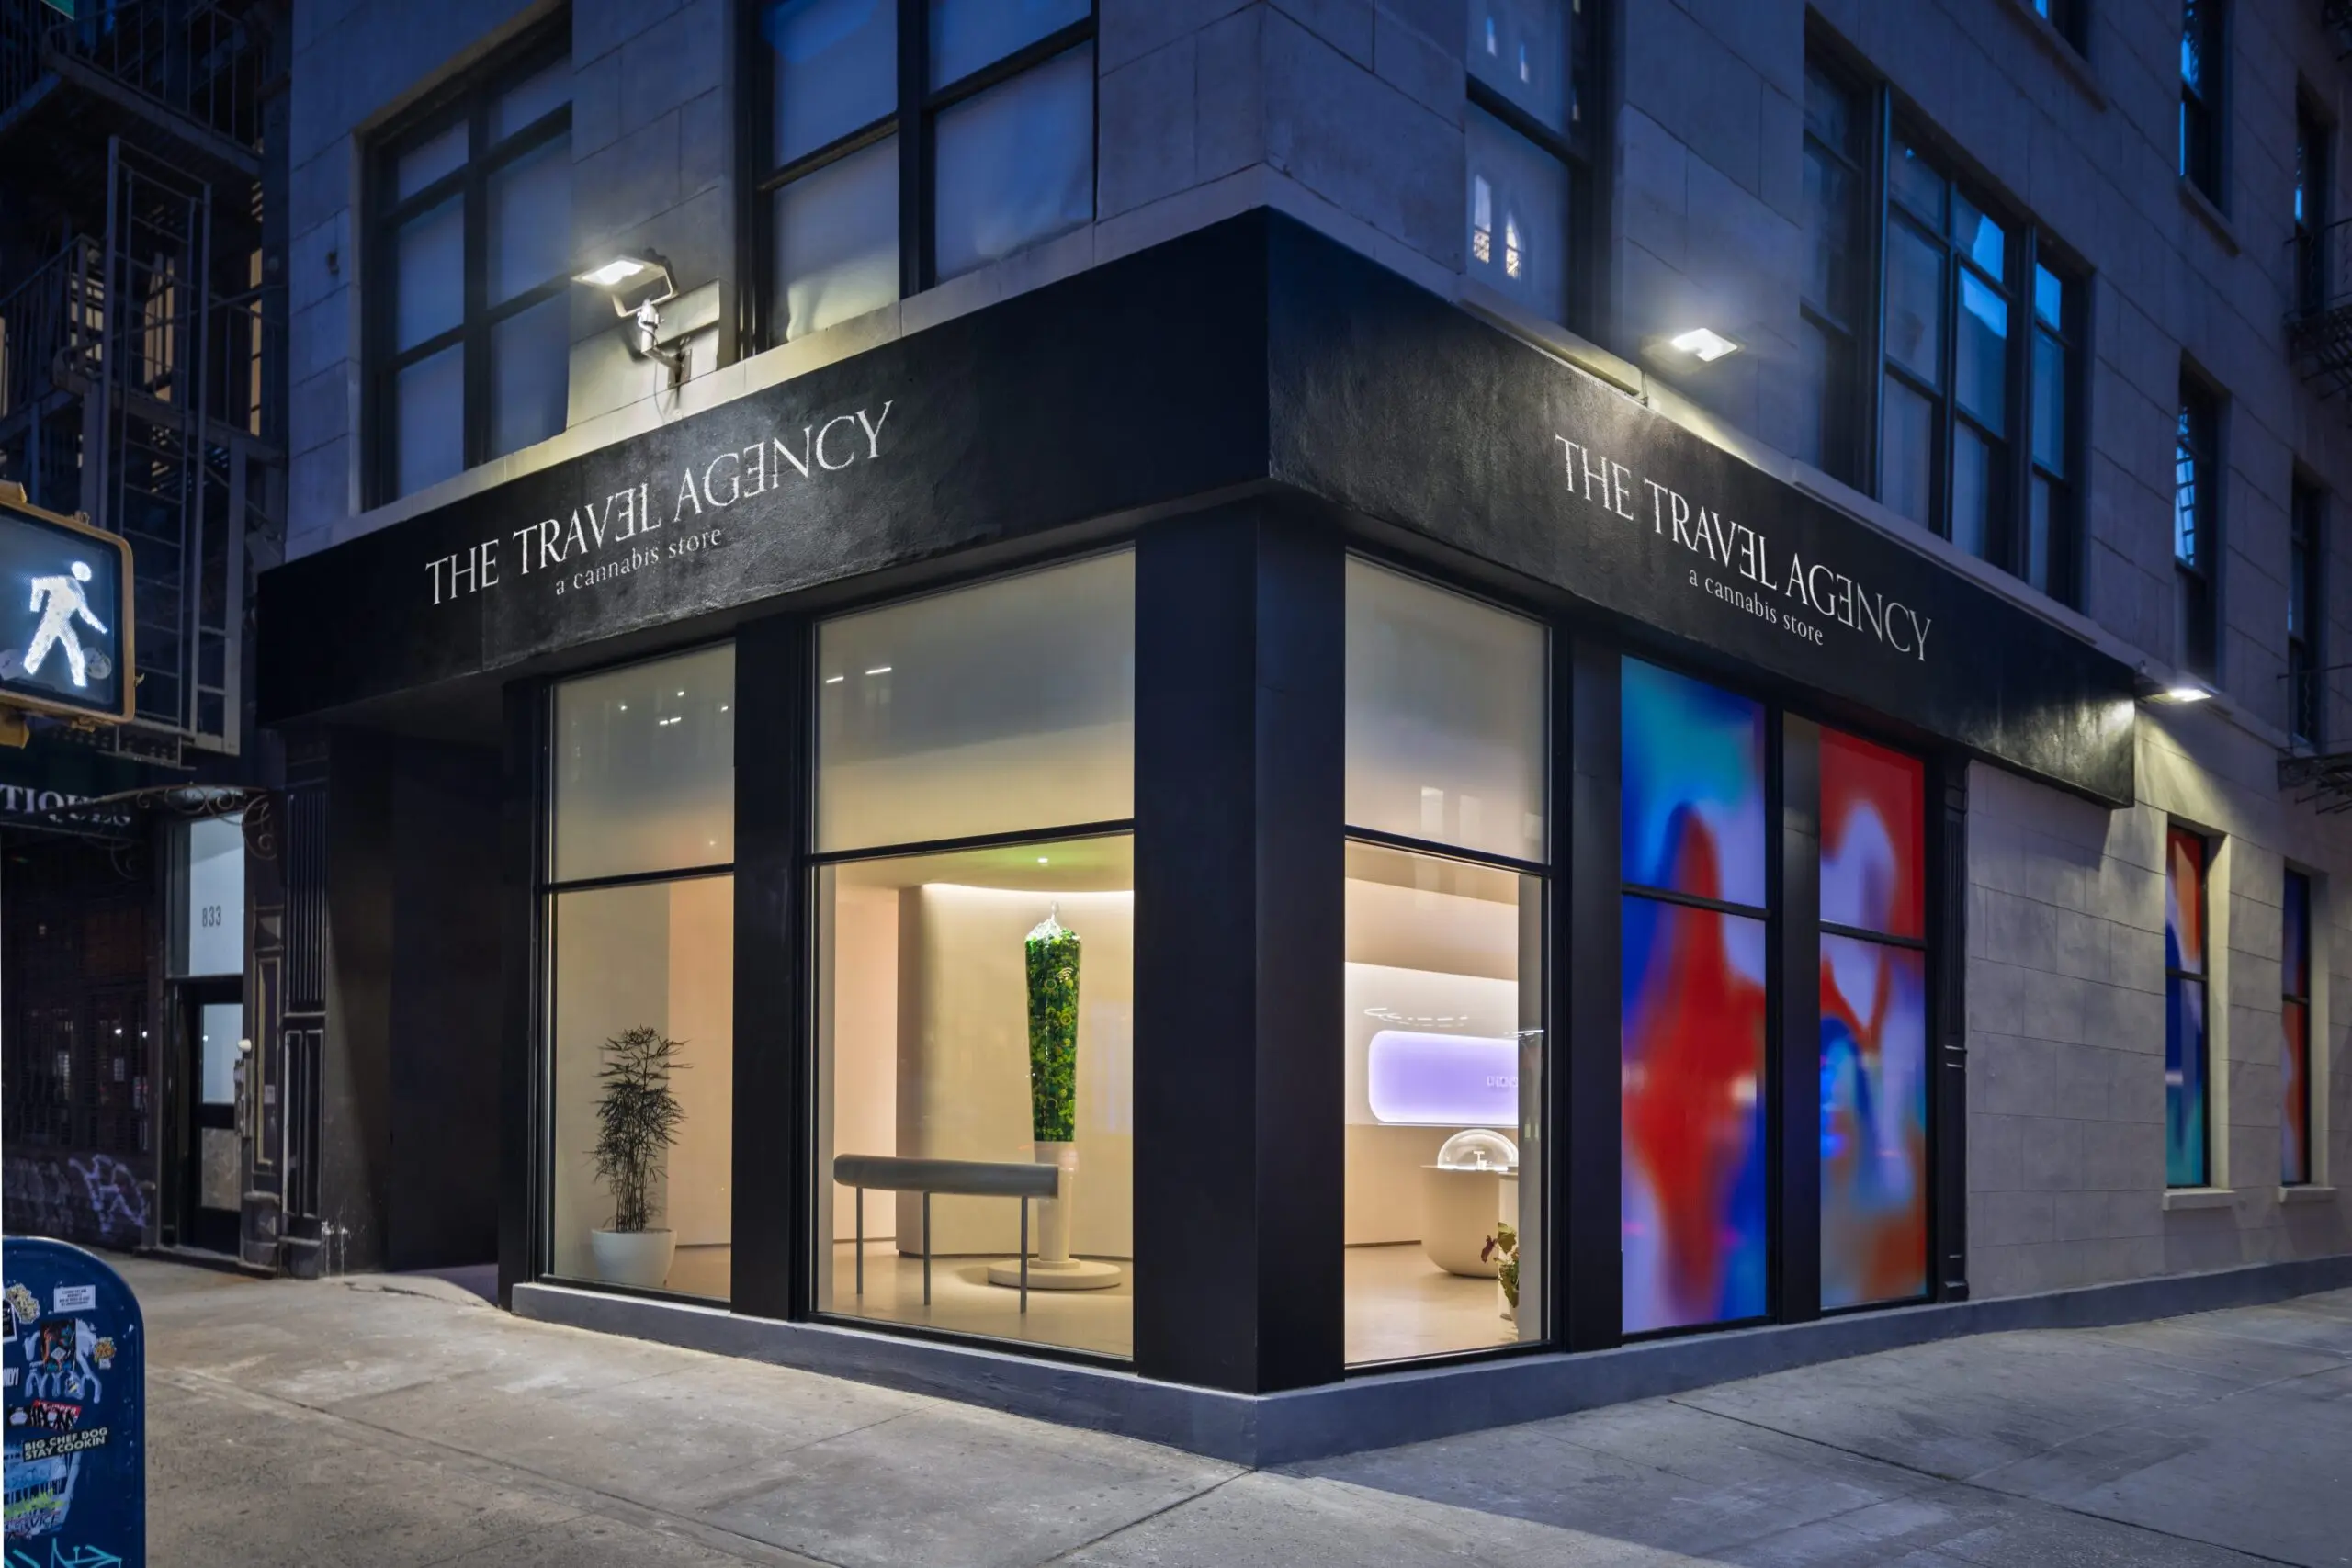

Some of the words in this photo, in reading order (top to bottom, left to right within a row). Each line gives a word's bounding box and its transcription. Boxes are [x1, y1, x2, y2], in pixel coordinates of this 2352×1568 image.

[425, 538, 501, 606] THE
[512, 481, 662, 574] TRAVEL
[673, 400, 894, 522] AGENCY
[555, 578, 565, 596] a
[573, 545, 660, 590] cannabis
[668, 527, 723, 558] store
[1555, 434, 1634, 522] THE
[1644, 477, 1778, 591] TRAVEL
[1784, 553, 1931, 661] AGENCY
[1689, 569, 1699, 588] a
[1705, 578, 1778, 624] cannabis
[1783, 613, 1824, 646] store
[202, 905, 221, 927] 833
[25, 1439, 45, 1451] BIG
[50, 1433, 78, 1447] CHEF
[81, 1427, 107, 1439] DOG
[25, 1448, 52, 1460] STAY
[57, 1436, 106, 1453] COOKIN
